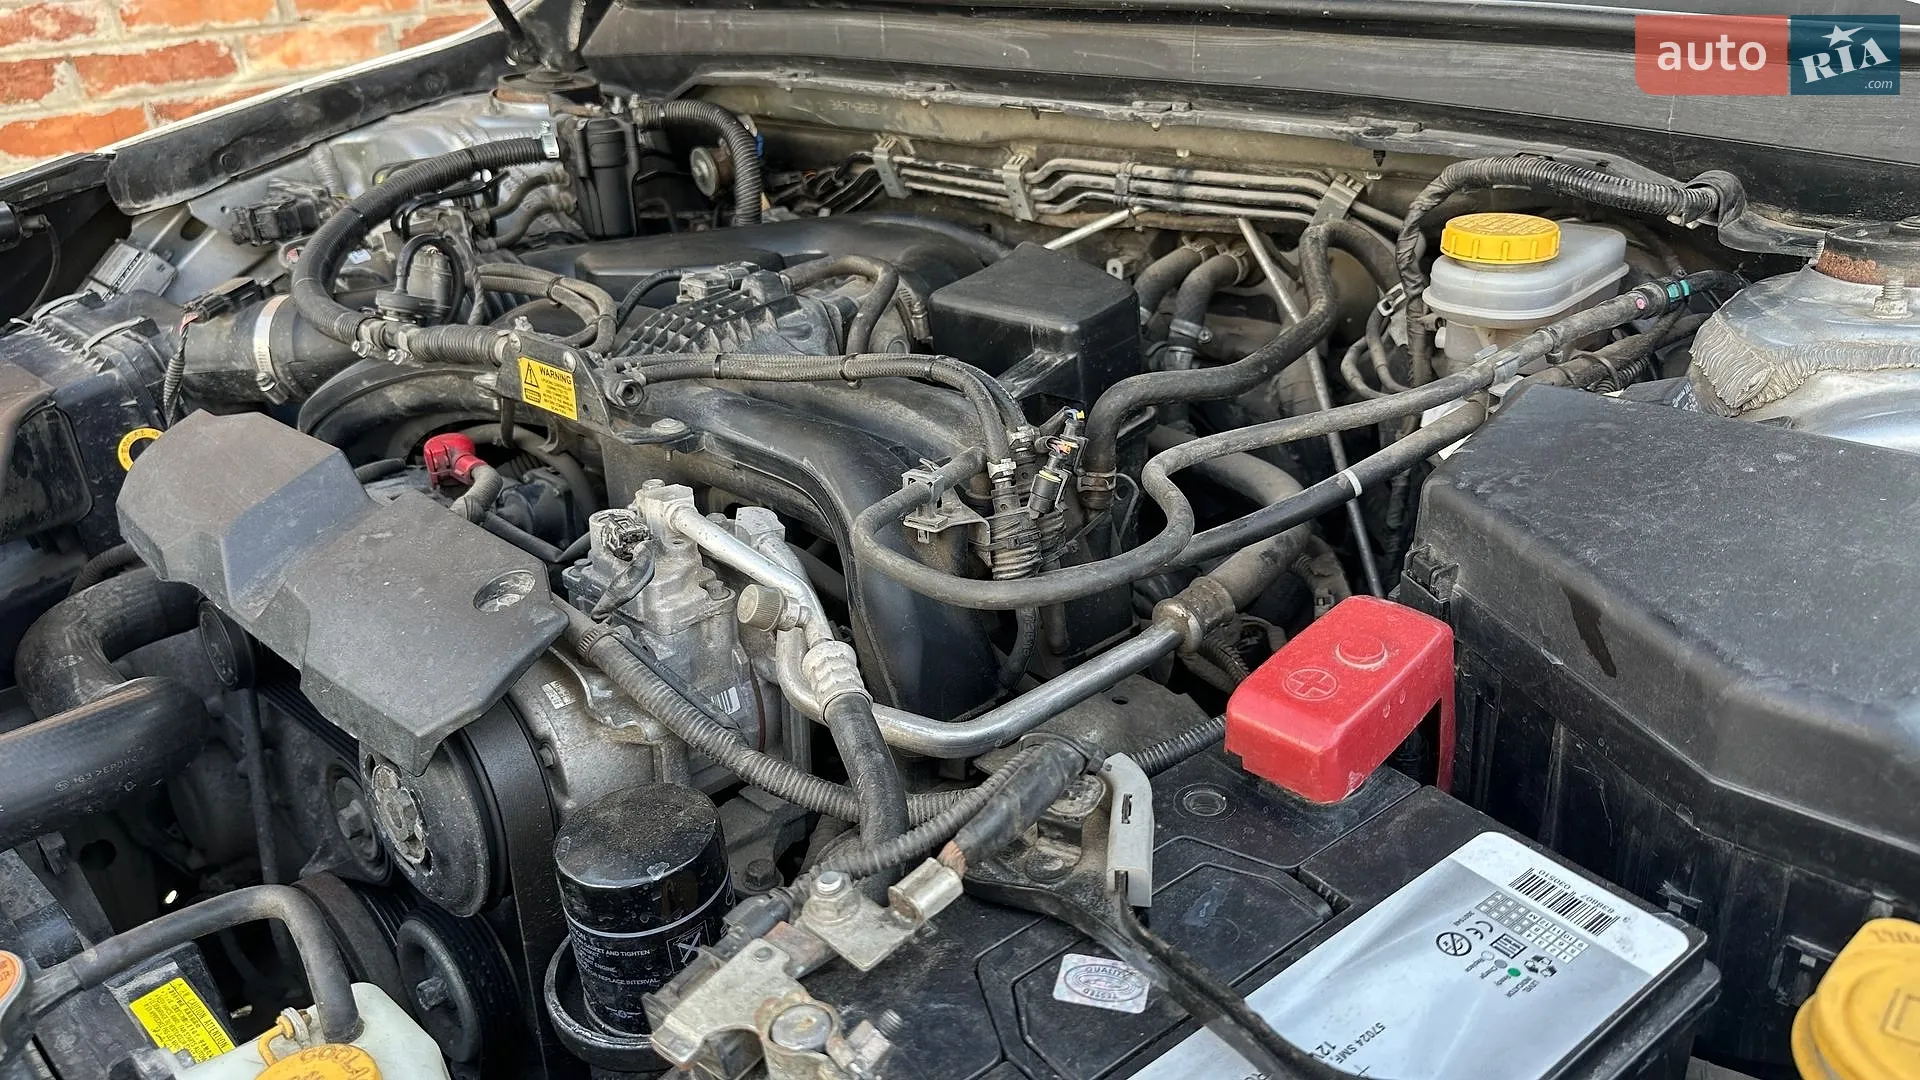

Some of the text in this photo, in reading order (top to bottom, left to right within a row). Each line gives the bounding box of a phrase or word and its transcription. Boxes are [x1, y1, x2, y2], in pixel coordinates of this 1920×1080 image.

[539, 366, 572, 385] WARNING
[1538, 869, 1571, 890] 030510
[605, 949, 620, 957] AND
[620, 949, 651, 957] TIGHTEN
[1085, 966, 1131, 981] QUALITY
[1083, 987, 1119, 1000] TESTED
[187, 998, 228, 1049] CAUTION ATTENTION
[1355, 1022, 1386, 1047] 57024
